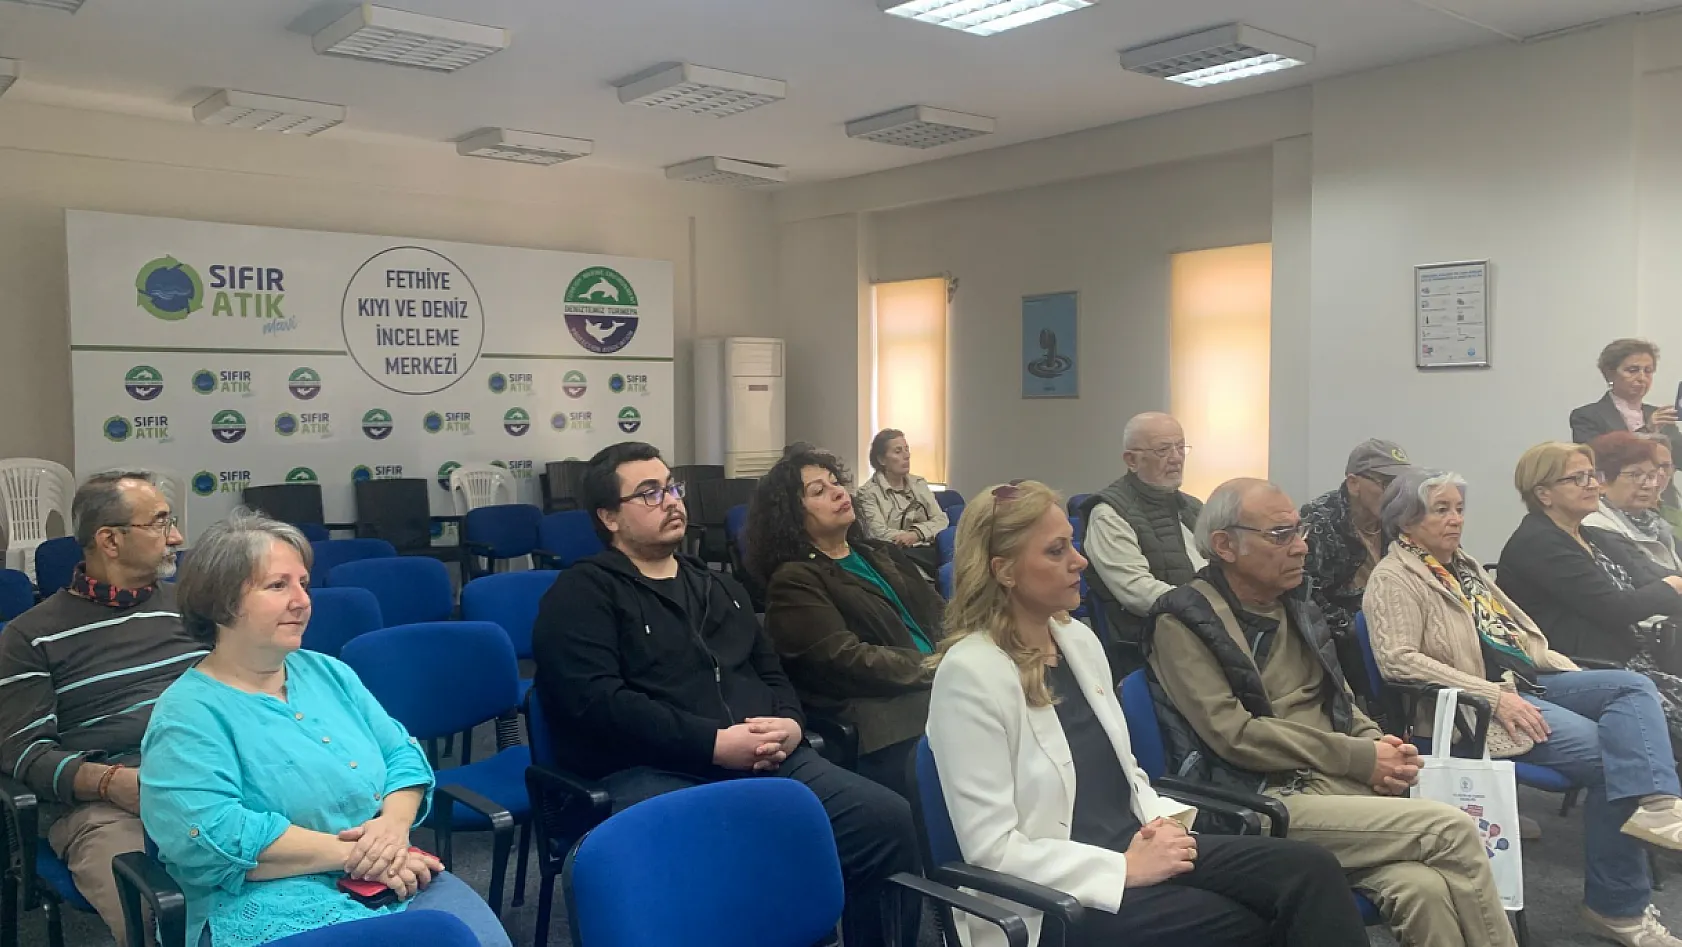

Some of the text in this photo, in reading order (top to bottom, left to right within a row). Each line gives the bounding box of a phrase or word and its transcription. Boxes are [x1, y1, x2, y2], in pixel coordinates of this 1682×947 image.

[209, 264, 285, 291] SIFIR
[386, 268, 451, 291] FETHİYE
[211, 291, 286, 318] ATIK
[358, 296, 469, 319] KIYI VE DENİZ
[376, 323, 460, 347] İNCELEME
[384, 352, 458, 375] MERKEZİ
[220, 370, 251, 381] SIFIR
[509, 373, 533, 382] SIFIR
[626, 374, 648, 383] SIFIR
[220, 381, 251, 393] ATIK
[300, 412, 330, 423] SIFIR
[445, 412, 471, 422] SIFIR
[569, 411, 592, 420] SIFIR
[134, 416, 168, 427] SIFIR
[135, 428, 169, 439] ATIK
[301, 423, 330, 434] ATIK
[375, 465, 403, 475] SIFIR
[509, 460, 533, 469] SIFIR
[219, 470, 251, 482] SIFIR
